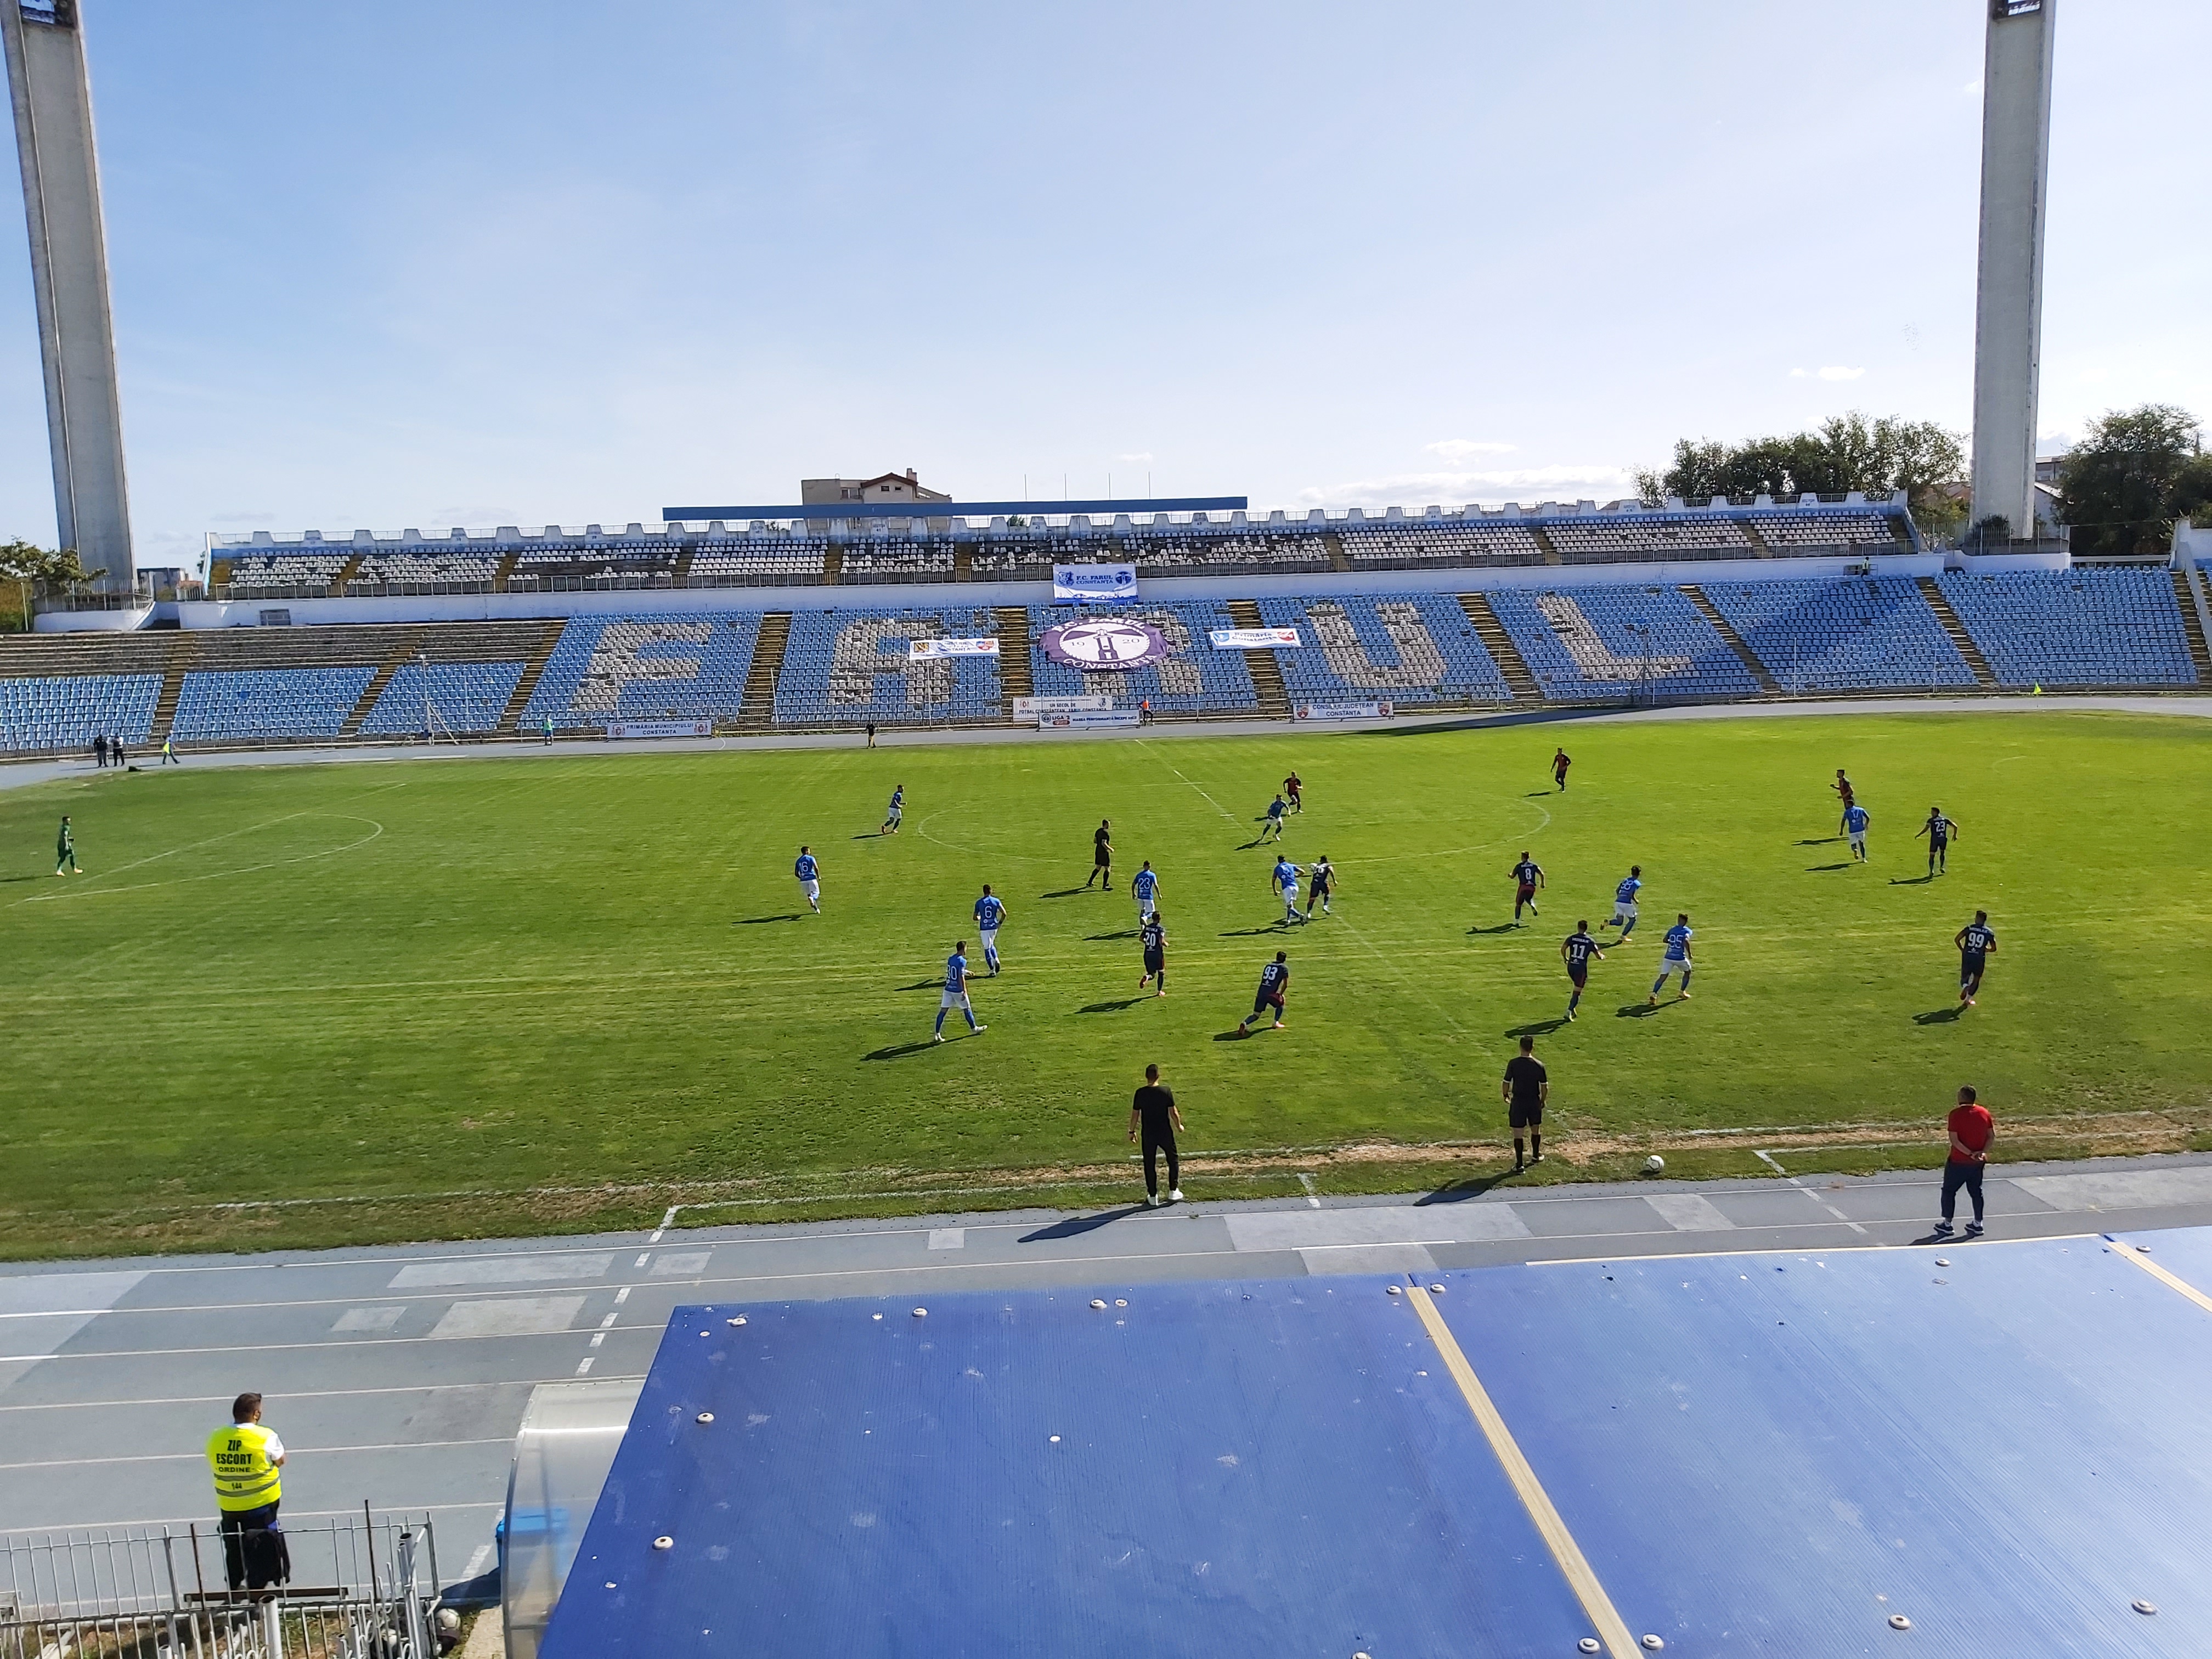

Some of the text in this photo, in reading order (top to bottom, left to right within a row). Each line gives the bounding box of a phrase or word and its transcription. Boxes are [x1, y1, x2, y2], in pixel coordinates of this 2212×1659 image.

[1051, 618, 1145, 632] F.C. FARUL
[1934, 821, 1945, 832] 23
[798, 861, 808, 872] 16
[1525, 868, 1532, 880] 8
[1138, 877, 1150, 889] 23
[984, 906, 992, 918] 6
[1145, 932, 1156, 946] 20
[1669, 934, 1684, 949] 95
[1967, 932, 1984, 947] 99
[1571, 944, 1585, 960] 11
[1263, 966, 1278, 980] 93
[227, 1440, 242, 1451] ZIP
[216, 1453, 252, 1465] ESCORT
